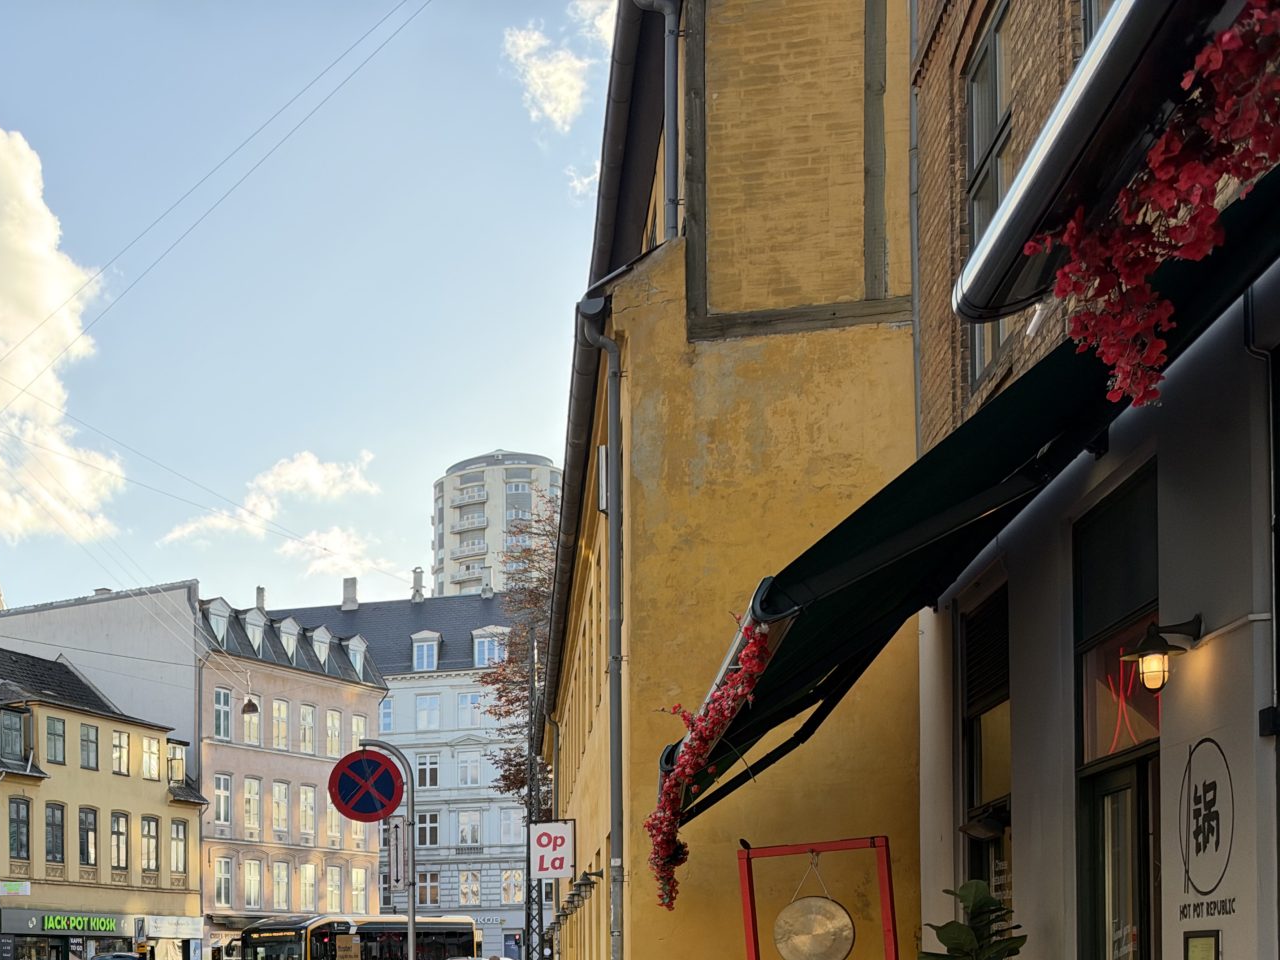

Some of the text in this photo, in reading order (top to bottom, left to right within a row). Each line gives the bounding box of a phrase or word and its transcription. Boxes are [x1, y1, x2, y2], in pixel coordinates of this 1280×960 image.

[1192, 779, 1220, 857] 锅
[535, 831, 566, 852] Op
[537, 854, 565, 872] La
[1179, 898, 1236, 921] HOT POT REPUBLIC
[43, 915, 116, 932] JACK POT KIOSK
